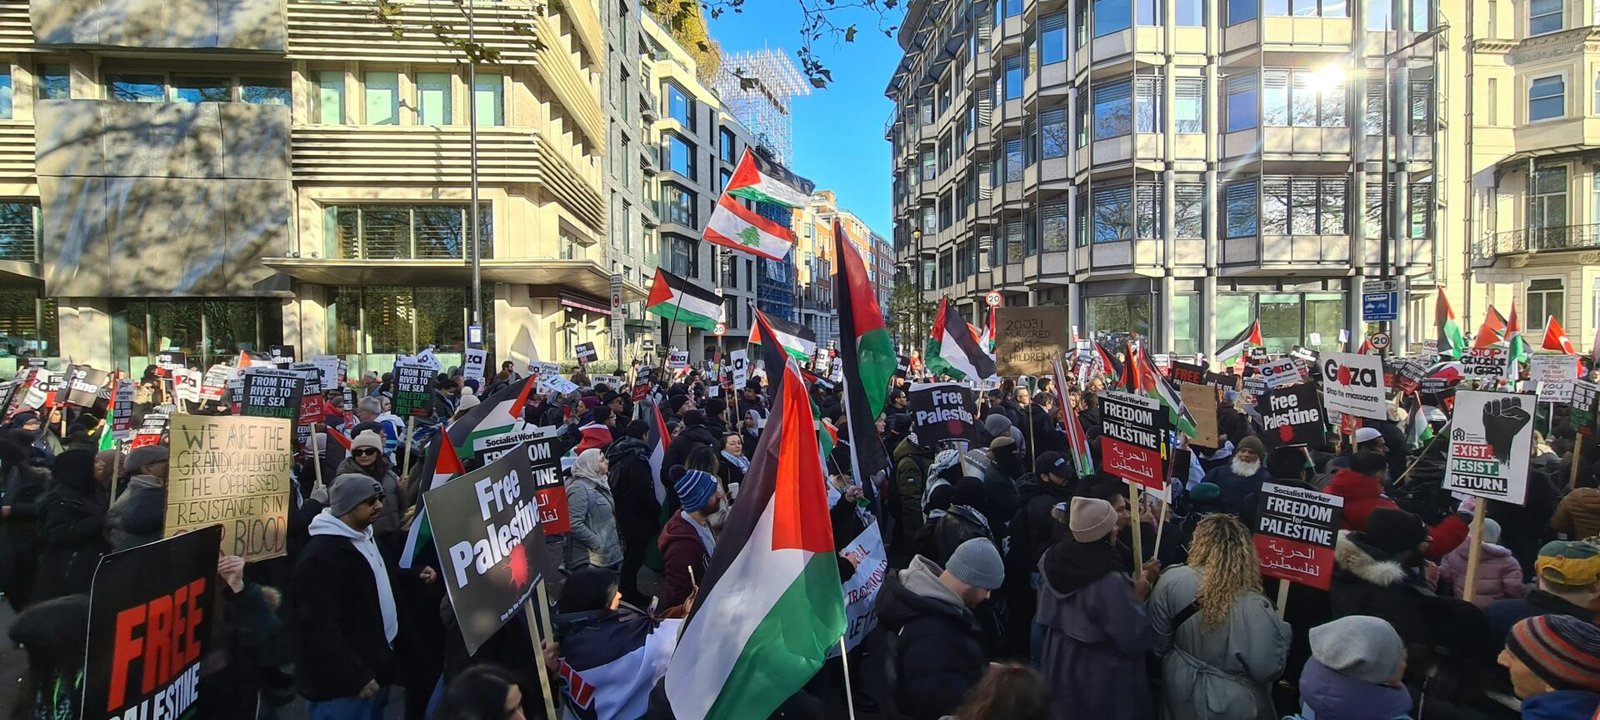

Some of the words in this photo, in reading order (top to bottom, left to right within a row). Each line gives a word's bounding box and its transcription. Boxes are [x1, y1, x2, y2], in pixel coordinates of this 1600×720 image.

[988, 295, 999, 303] 20
[1006, 318, 1044, 331] 20031
[1374, 337, 1387, 345] 20
[1002, 352, 1051, 363] CHILDREN
[1460, 356, 1507, 366] GENOCIDE
[1470, 348, 1502, 358] STOP
[400, 368, 419, 376] FROM
[420, 370, 433, 379] THE
[1175, 368, 1201, 382] FREE
[1261, 362, 1293, 377] Gza
[1324, 358, 1378, 388] Gza
[1400, 369, 1422, 383] PALESTINE
[1405, 363, 1425, 376] FREEDOM
[1474, 367, 1504, 378] GAZA
[251, 376, 279, 387] FROM
[280, 378, 298, 388] THE
[412, 384, 424, 393] SEA
[250, 386, 276, 397] RIVER
[279, 387, 291, 397] TO
[397, 391, 432, 400] PALESTINE
[931, 389, 963, 406] Free
[1106, 391, 1130, 403] Socialist
[1129, 396, 1150, 407] Worker
[1345, 392, 1379, 403] massacre
[249, 396, 267, 406] THE
[268, 397, 286, 407] SEA
[396, 399, 414, 407] WILL
[1270, 394, 1299, 411] Free
[247, 406, 294, 417] PALESTINE
[915, 406, 974, 426] Palestine
[1104, 401, 1154, 426] FREEDOM
[1263, 408, 1320, 431] Palestine
[1123, 420, 1133, 428] for
[182, 424, 220, 451] WE
[226, 424, 257, 451] ARE
[261, 426, 285, 451] THE
[486, 433, 518, 447] Socialist
[518, 430, 545, 443] Worker
[1103, 421, 1157, 449] PALESTINE
[1113, 443, 1148, 462] الحرية
[1452, 444, 1491, 458] EXIST.
[177, 450, 276, 476] GRANDCHILDREN
[278, 453, 289, 472] OF
[1110, 458, 1154, 478] لفلسطين
[1452, 459, 1498, 475] RESIST.
[178, 477, 213, 498] THE
[218, 474, 280, 495] OPPRESSED
[1451, 474, 1508, 492] RETURN.
[475, 469, 521, 522] Free
[1273, 486, 1304, 498] Socialist
[1304, 491, 1331, 503] Worker
[177, 497, 256, 525] RESISTANCE
[261, 497, 271, 514] IS
[272, 495, 284, 513] IN
[1266, 496, 1333, 523] FREEDOM
[1292, 515, 1303, 524] for
[234, 515, 287, 556] BLOOD
[1259, 517, 1333, 546] PALESTINE
[449, 496, 541, 590] Palestine
[1268, 540, 1316, 560] الحرية
[1260, 556, 1320, 577] لفلسطين
[107, 577, 207, 713] FREE
